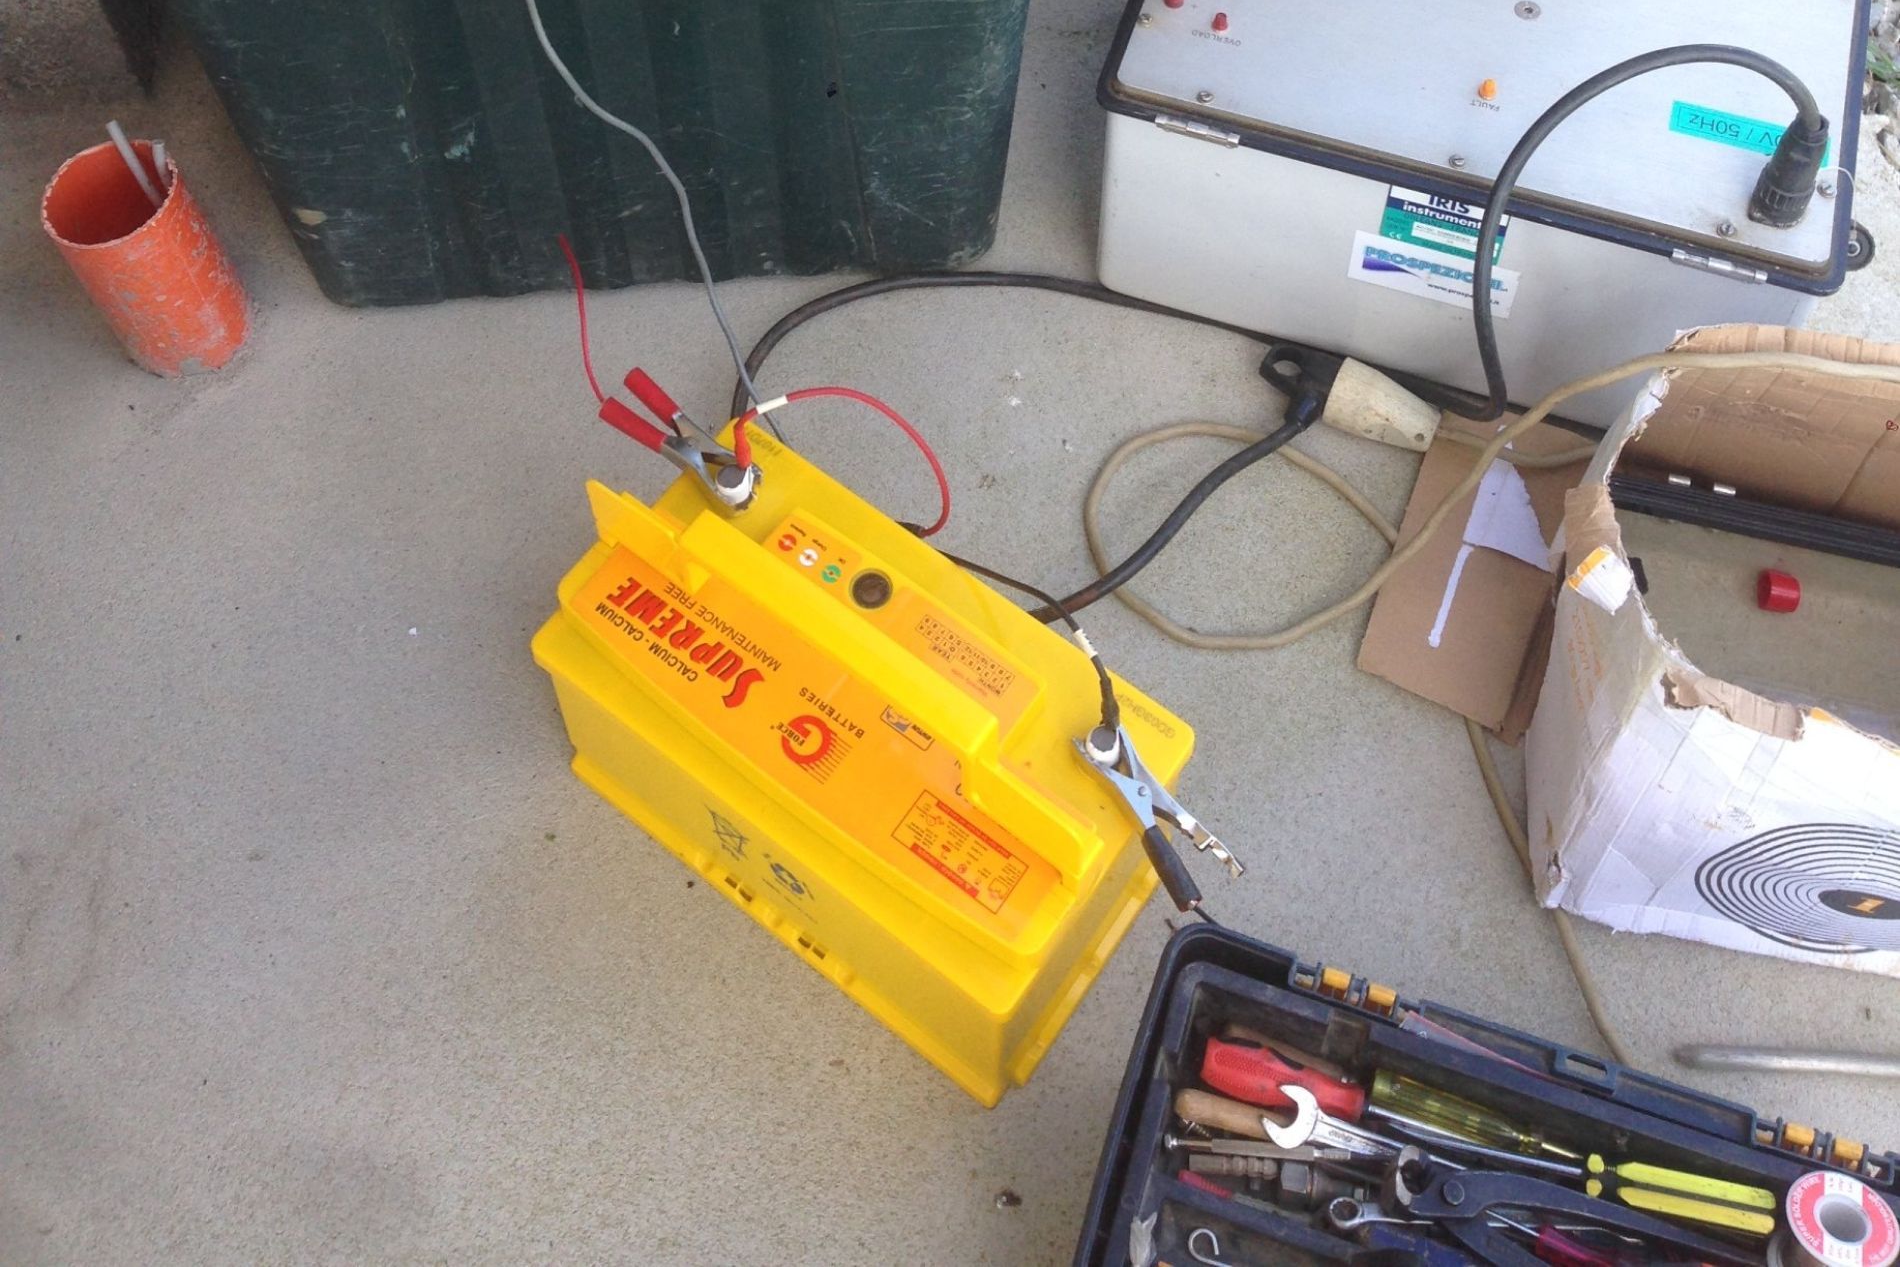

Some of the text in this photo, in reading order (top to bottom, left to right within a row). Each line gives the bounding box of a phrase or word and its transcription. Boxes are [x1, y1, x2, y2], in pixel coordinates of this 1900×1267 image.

[1191, 29, 1241, 47] OVERLOAD
[1468, 98, 1500, 112] FAULT
[1687, 114, 1740, 138] 50Hz
[1402, 201, 1481, 229] instrument
[1428, 193, 1471, 215] IRIS
[594, 600, 645, 643] CALCIUM
[662, 579, 782, 672] MAINTENANCE FREE
[607, 576, 766, 709] SUPREME
[930, 643, 951, 660] YEAR
[647, 639, 699, 683] CALCIUM
[797, 685, 865, 739] BATTERIES
[774, 720, 806, 747] FORCE
